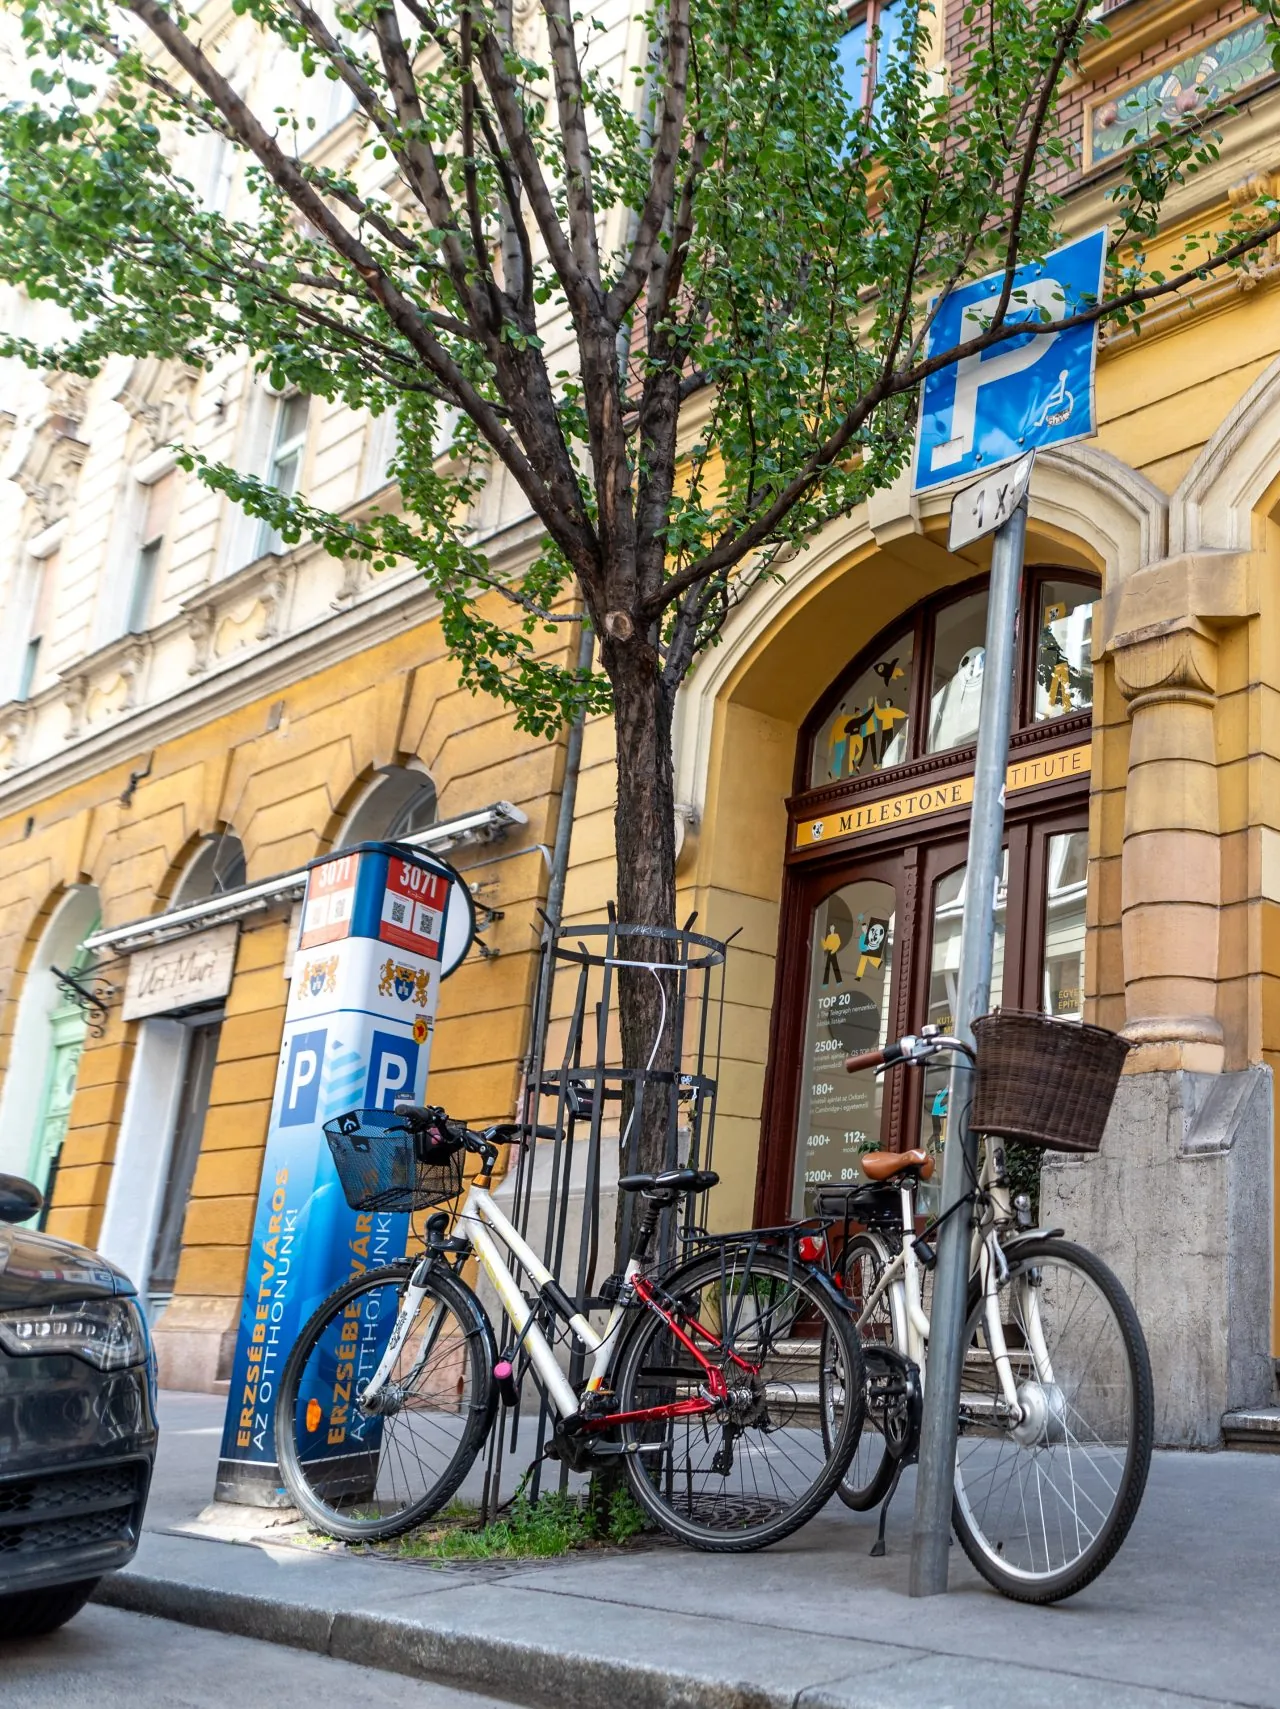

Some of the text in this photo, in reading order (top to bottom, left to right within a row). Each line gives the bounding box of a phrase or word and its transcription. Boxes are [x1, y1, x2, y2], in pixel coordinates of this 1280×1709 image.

[951, 278, 1066, 456] P
[838, 752, 1082, 833] MILESTONE TITUTE
[318, 856, 352, 888] 3071
[399, 861, 438, 899] 3071
[818, 993, 851, 1009] TOP 20
[814, 1039, 843, 1053] 2500+
[289, 1050, 317, 1109] P
[374, 1052, 408, 1109] P
[811, 1083, 834, 1096] 180+
[806, 1131, 867, 1147] 400+ 112+
[804, 1168, 860, 1183] 1200+ 80+
[237, 1166, 289, 1447] ERZSÉBETVÁROS
[253, 1207, 298, 1451] AZ OTTHONUNK!
[327, 1168, 377, 1445] ERZSÉBEVÁR
